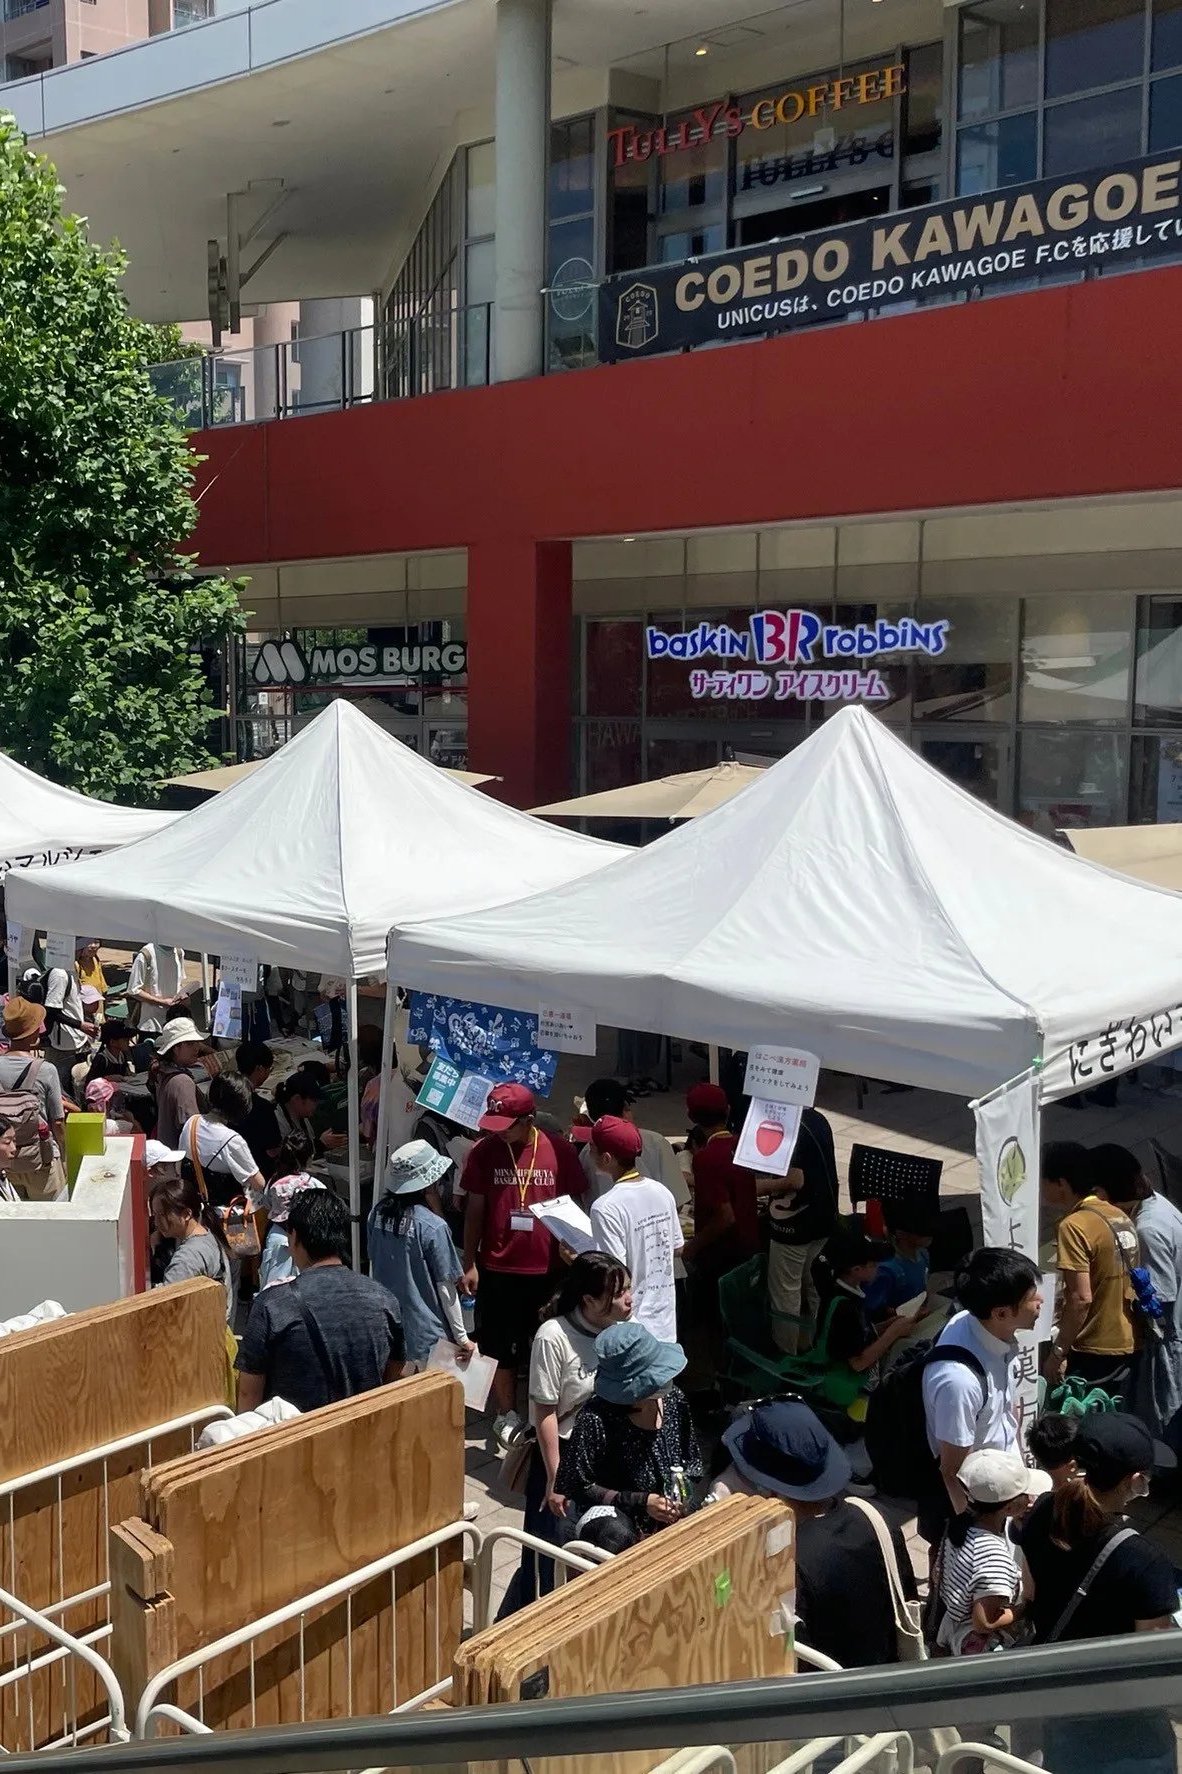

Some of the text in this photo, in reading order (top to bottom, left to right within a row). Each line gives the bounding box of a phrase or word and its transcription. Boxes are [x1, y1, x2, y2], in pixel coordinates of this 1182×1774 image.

[752, 64, 907, 131] COFFEE
[675, 160, 1181, 312] COEDO KAWAGOE
[718, 295, 818, 330] UNICUSは、
[826, 276, 904, 308] COEDO
[910, 249, 1026, 290] KAWAGOE
[312, 646, 378, 675] MOS
[647, 610, 946, 663] baskin BR robbins
[691, 670, 888, 699] サーティワン アイスクリーム
[1069, 1002, 1182, 1086] にぎわい
[749, 1075, 810, 1092] チェックをしてみよう
[533, 1177, 555, 1186] CLUB
